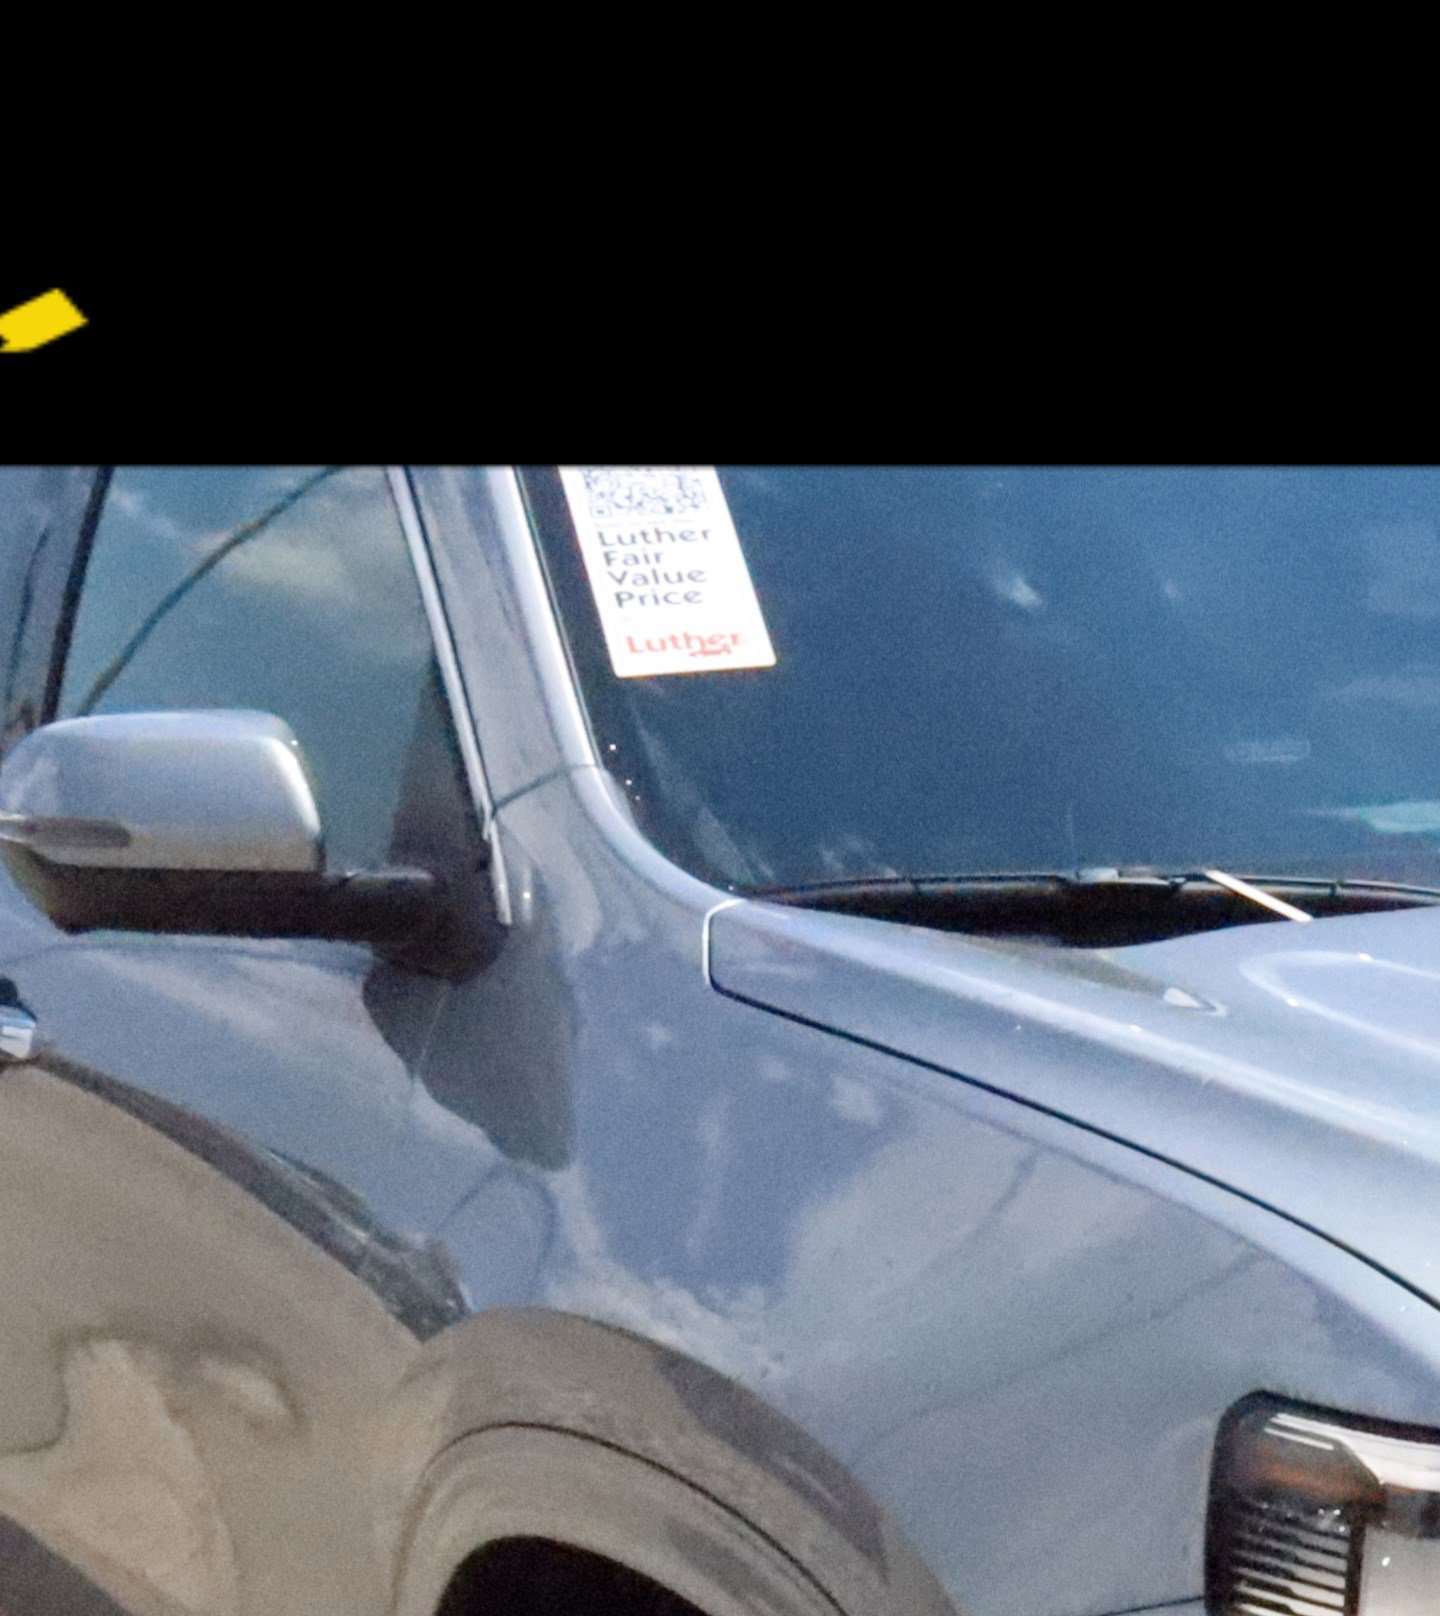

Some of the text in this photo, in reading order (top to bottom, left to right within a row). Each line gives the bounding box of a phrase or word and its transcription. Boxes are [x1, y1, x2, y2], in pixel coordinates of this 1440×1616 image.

[597, 526, 712, 548] Luther
[602, 550, 665, 568] Fair
[607, 567, 708, 587] Value
[615, 589, 704, 608] Price
[626, 632, 741, 655] Luther
